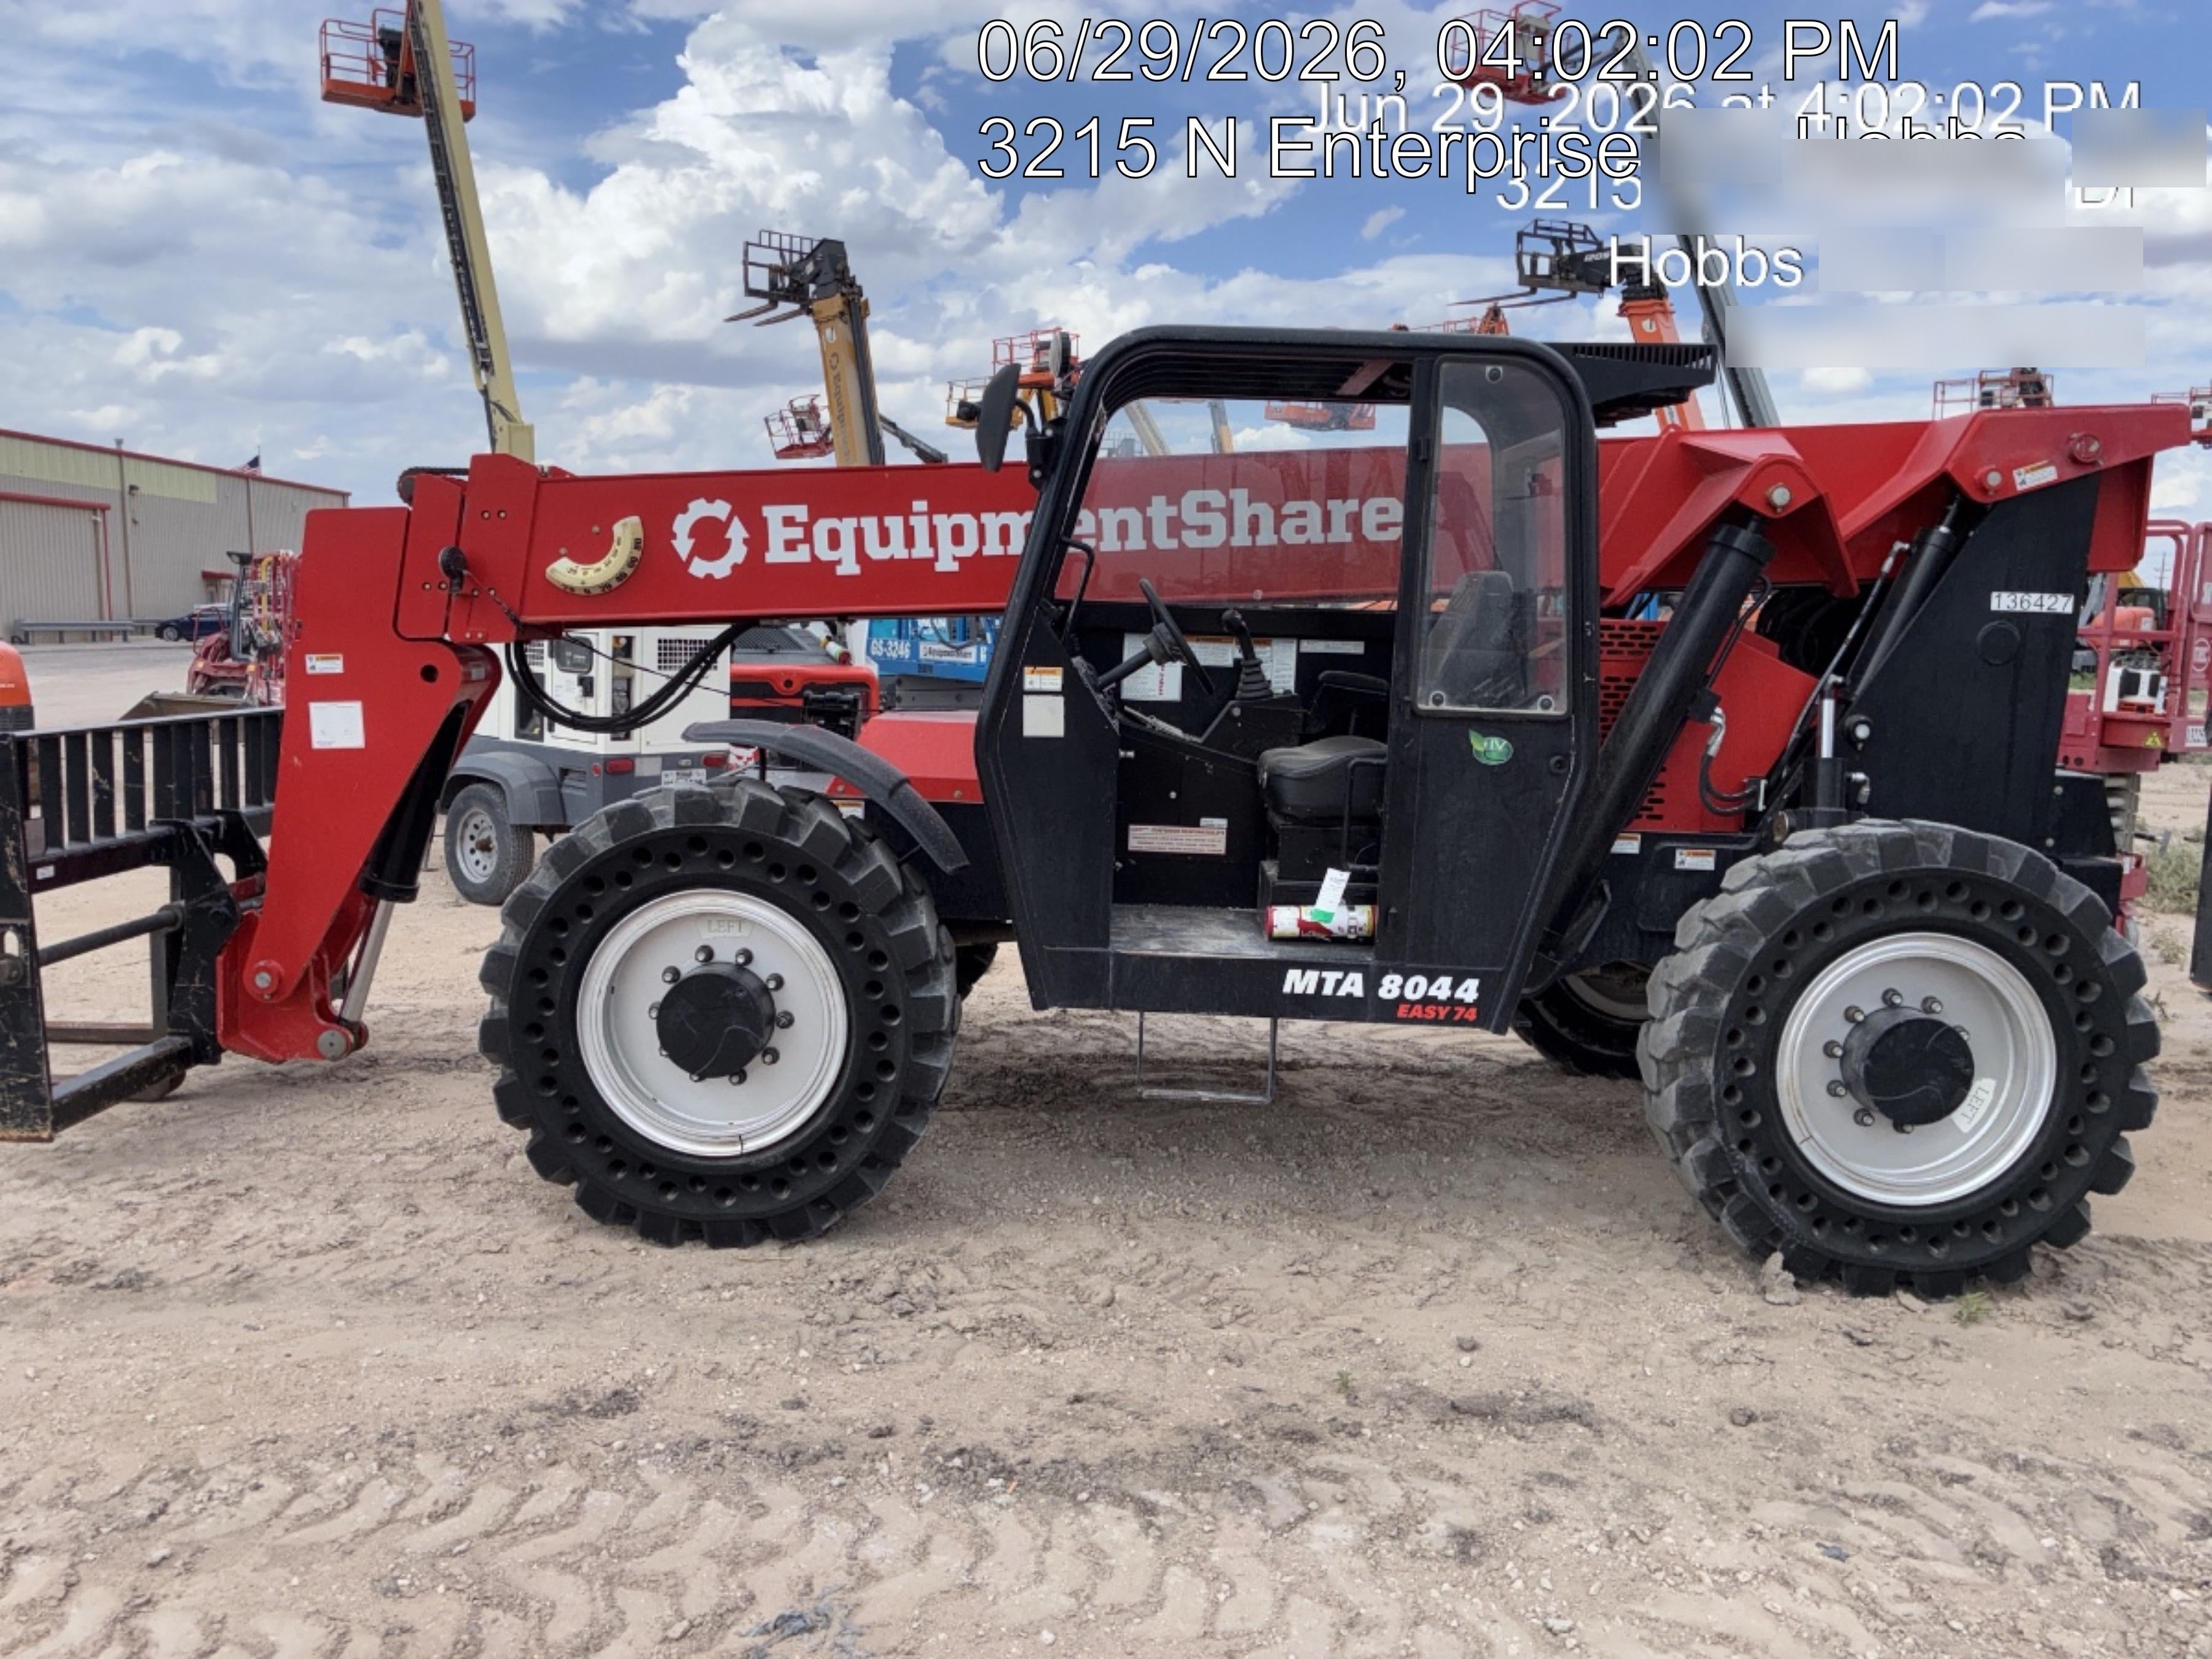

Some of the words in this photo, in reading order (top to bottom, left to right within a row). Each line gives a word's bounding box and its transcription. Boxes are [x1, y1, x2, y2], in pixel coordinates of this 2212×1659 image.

[1994, 593, 2071, 611] 136427
[870, 639, 911, 659] GS-3246
[1283, 969, 1364, 997] MTA
[1378, 974, 1480, 1003] 8044
[1397, 1003, 1451, 1020] EASY
[1453, 1006, 1478, 1022] 74
